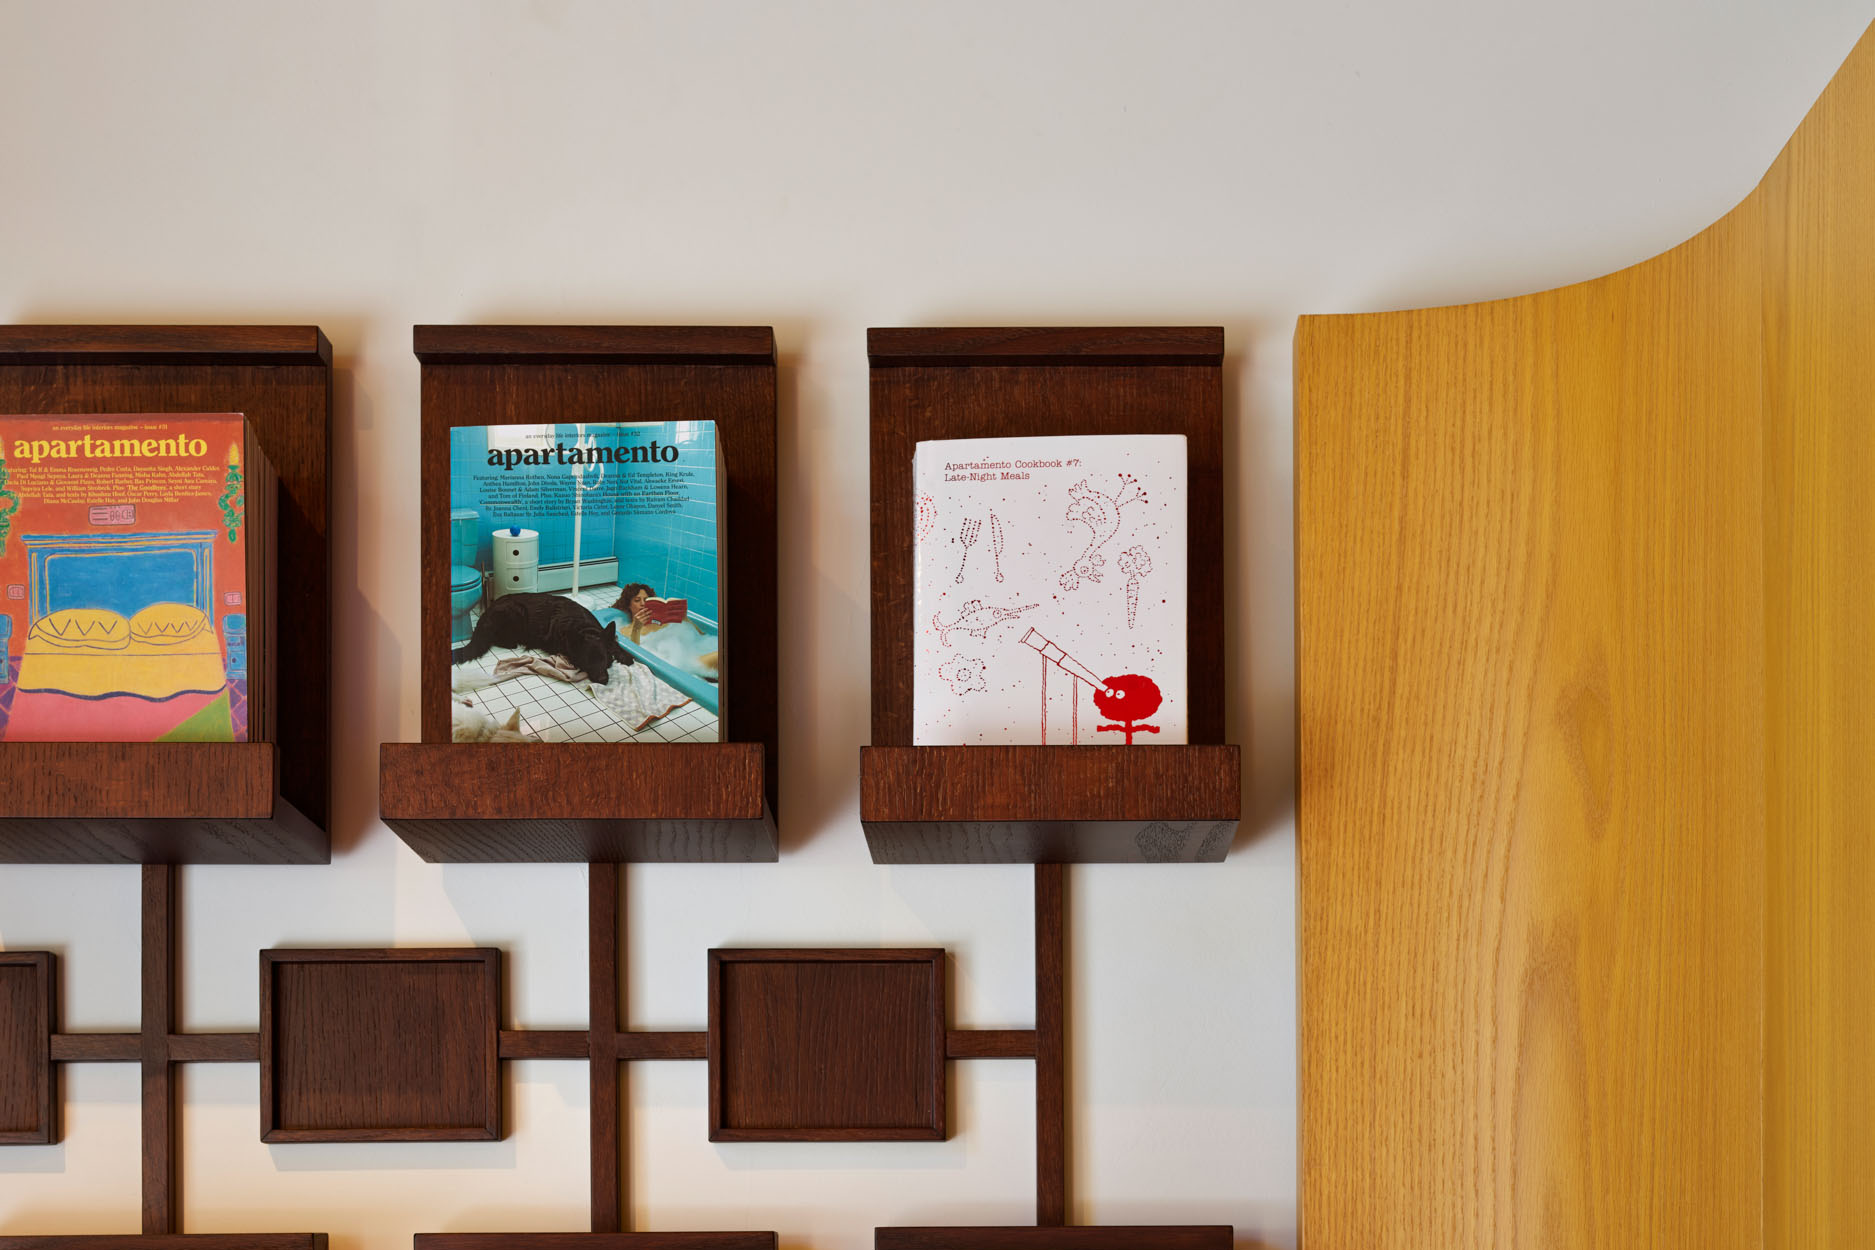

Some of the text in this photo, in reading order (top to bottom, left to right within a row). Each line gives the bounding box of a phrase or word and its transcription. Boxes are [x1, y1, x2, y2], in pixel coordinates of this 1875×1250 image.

[14, 433, 208, 464] apartamento
[488, 440, 679, 470] apartamento
[944, 460, 1011, 471] Apartamento
[1015, 459, 1062, 468] Cookbook
[944, 471, 1030, 482] Late-Night Meals
